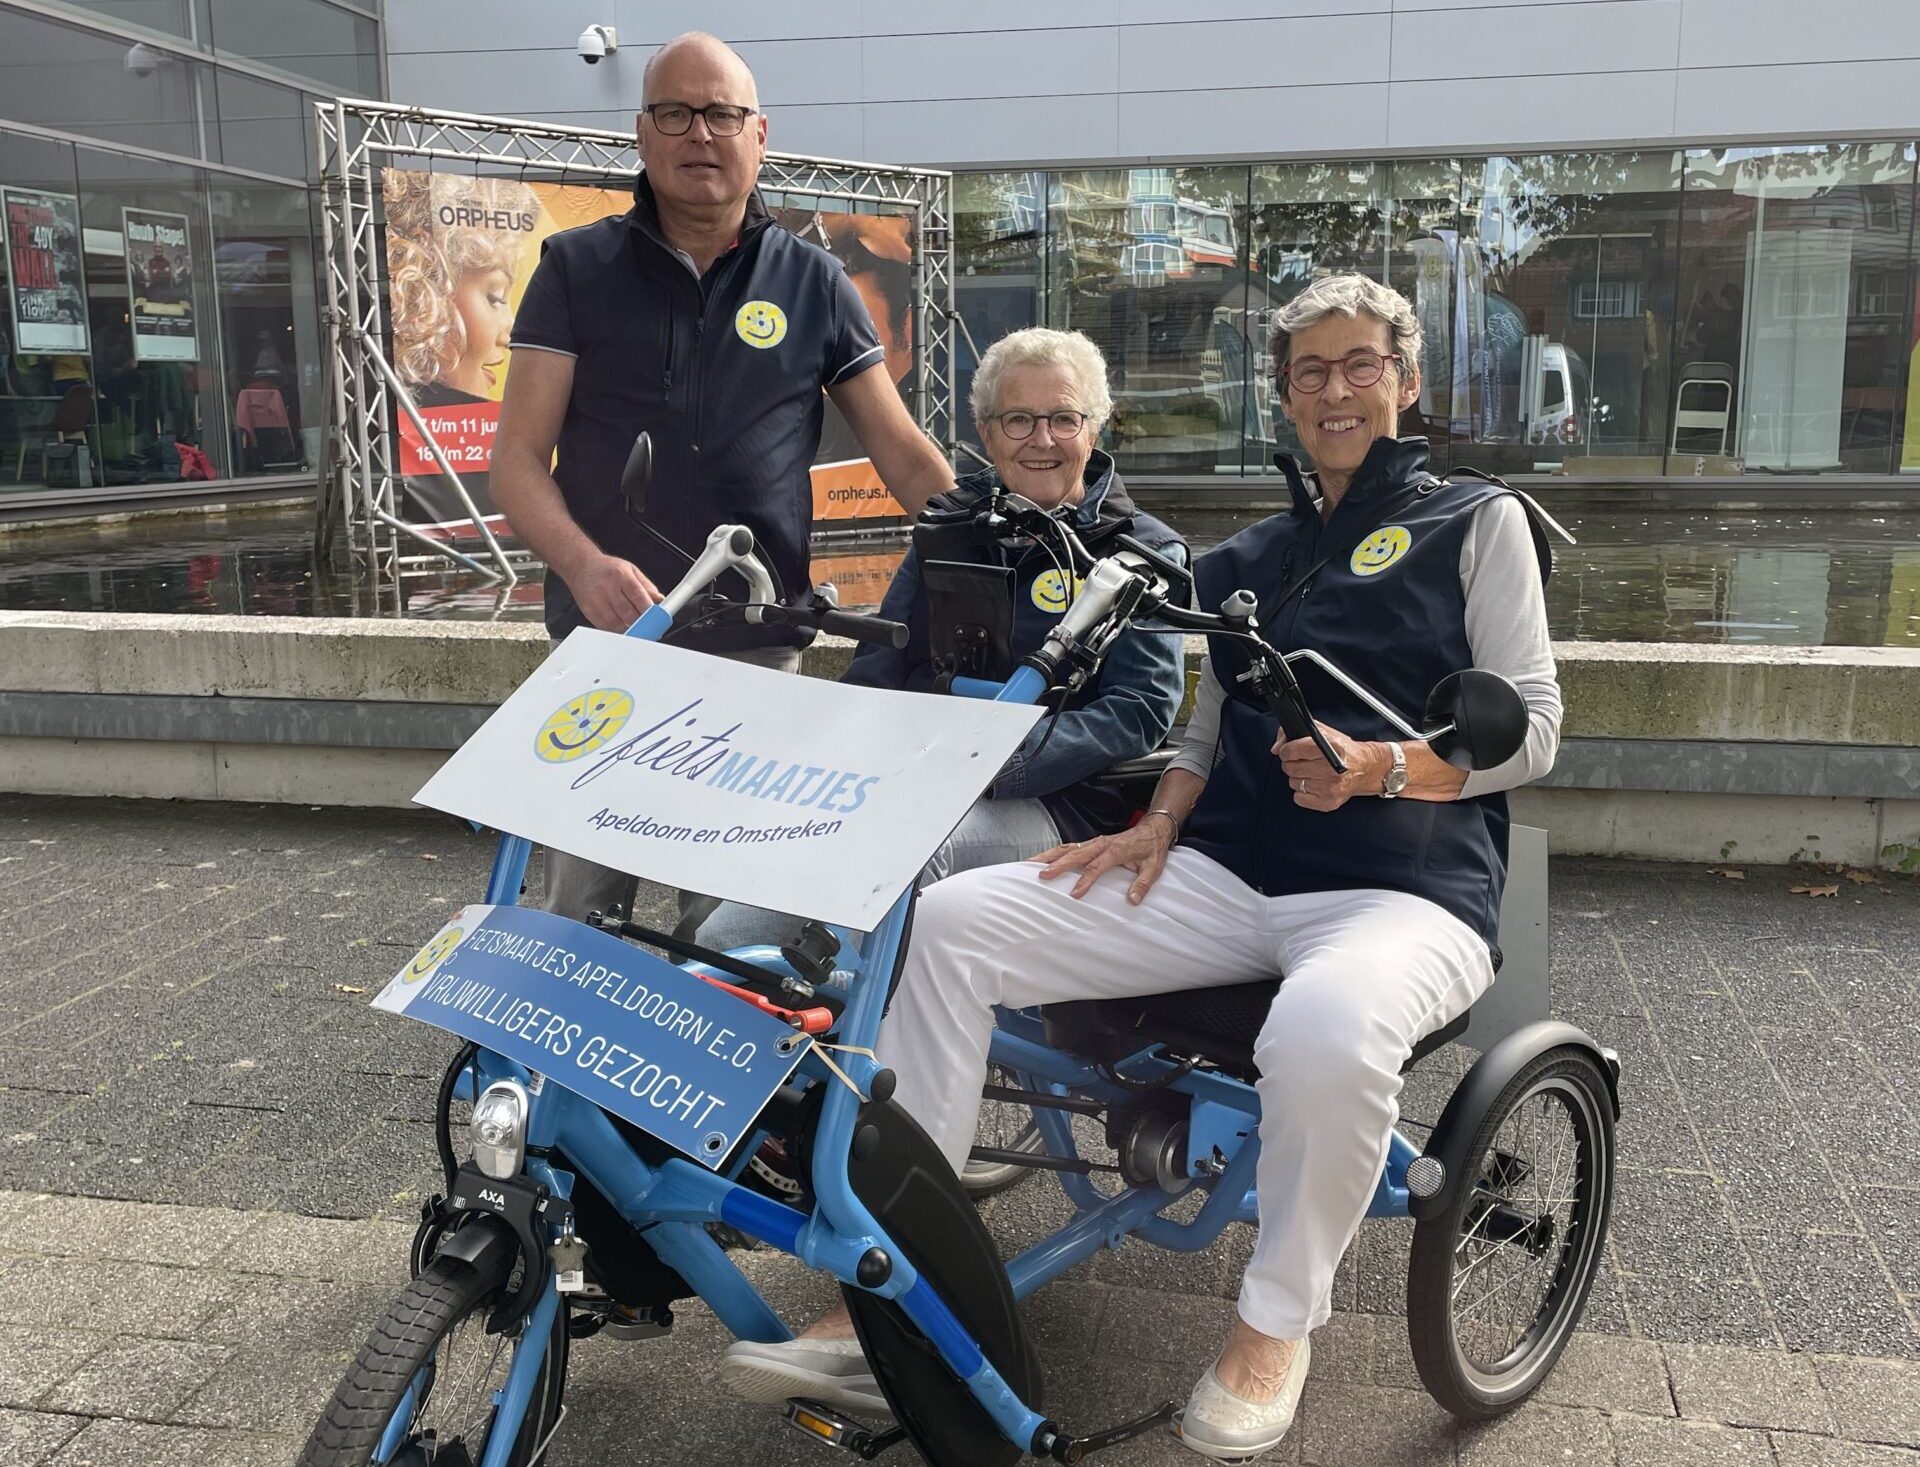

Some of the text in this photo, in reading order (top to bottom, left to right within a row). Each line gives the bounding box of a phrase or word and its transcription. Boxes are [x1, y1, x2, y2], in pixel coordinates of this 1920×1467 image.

[440, 205, 534, 232] ORPHEUS
[430, 418, 457, 433] t/m
[460, 418, 477, 433] 11
[437, 446, 462, 461] /m
[465, 446, 484, 461] 22
[587, 807, 842, 844] Apeldoorn en Omstreken
[463, 928, 756, 1073] FIETSMAATJES APELDOORN E.O.
[421, 972, 726, 1129] VRIJWILLIGERS GEZOCHT
[478, 1189, 505, 1206] AXA
